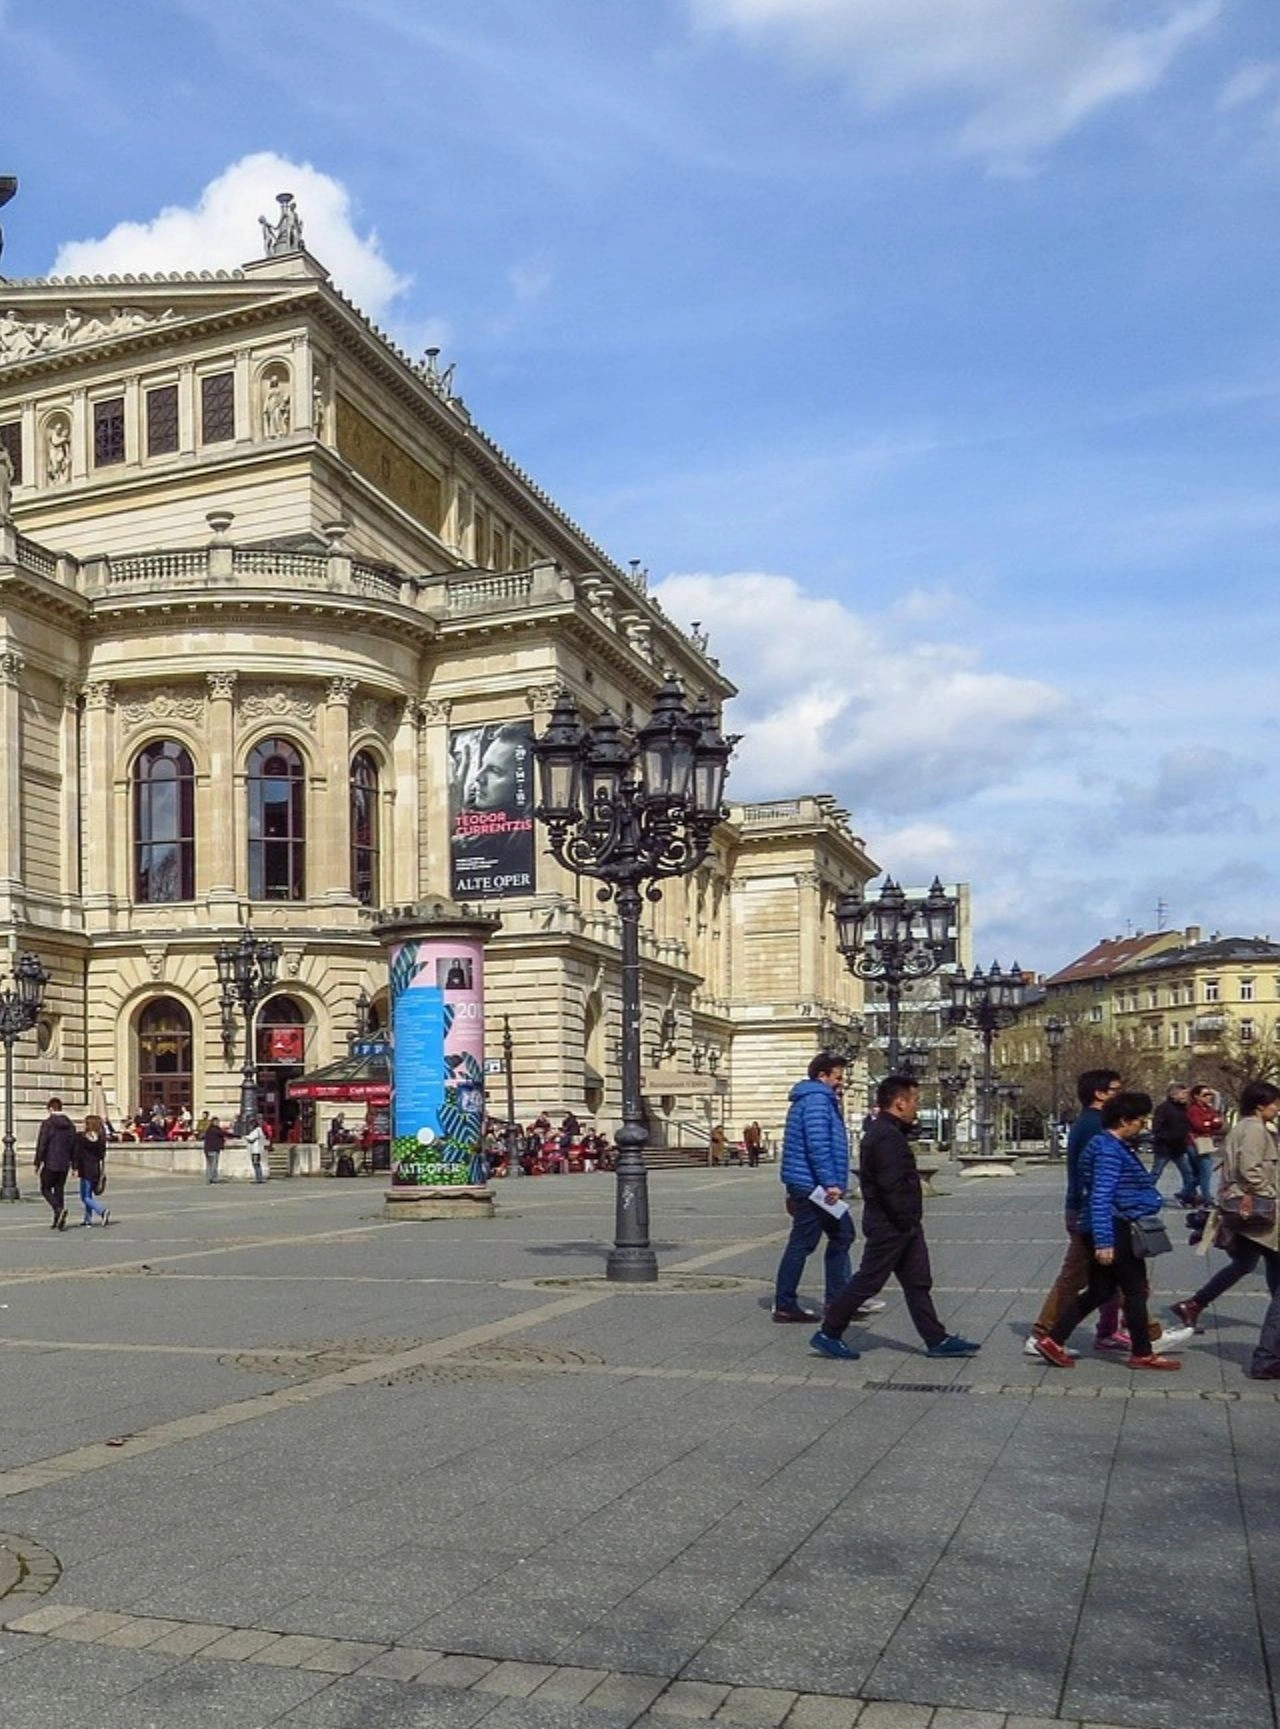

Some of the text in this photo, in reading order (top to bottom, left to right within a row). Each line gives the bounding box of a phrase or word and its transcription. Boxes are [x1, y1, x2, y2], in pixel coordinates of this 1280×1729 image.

[456, 811, 507, 826] TEODOR
[457, 872, 531, 891] ALTE OPER
